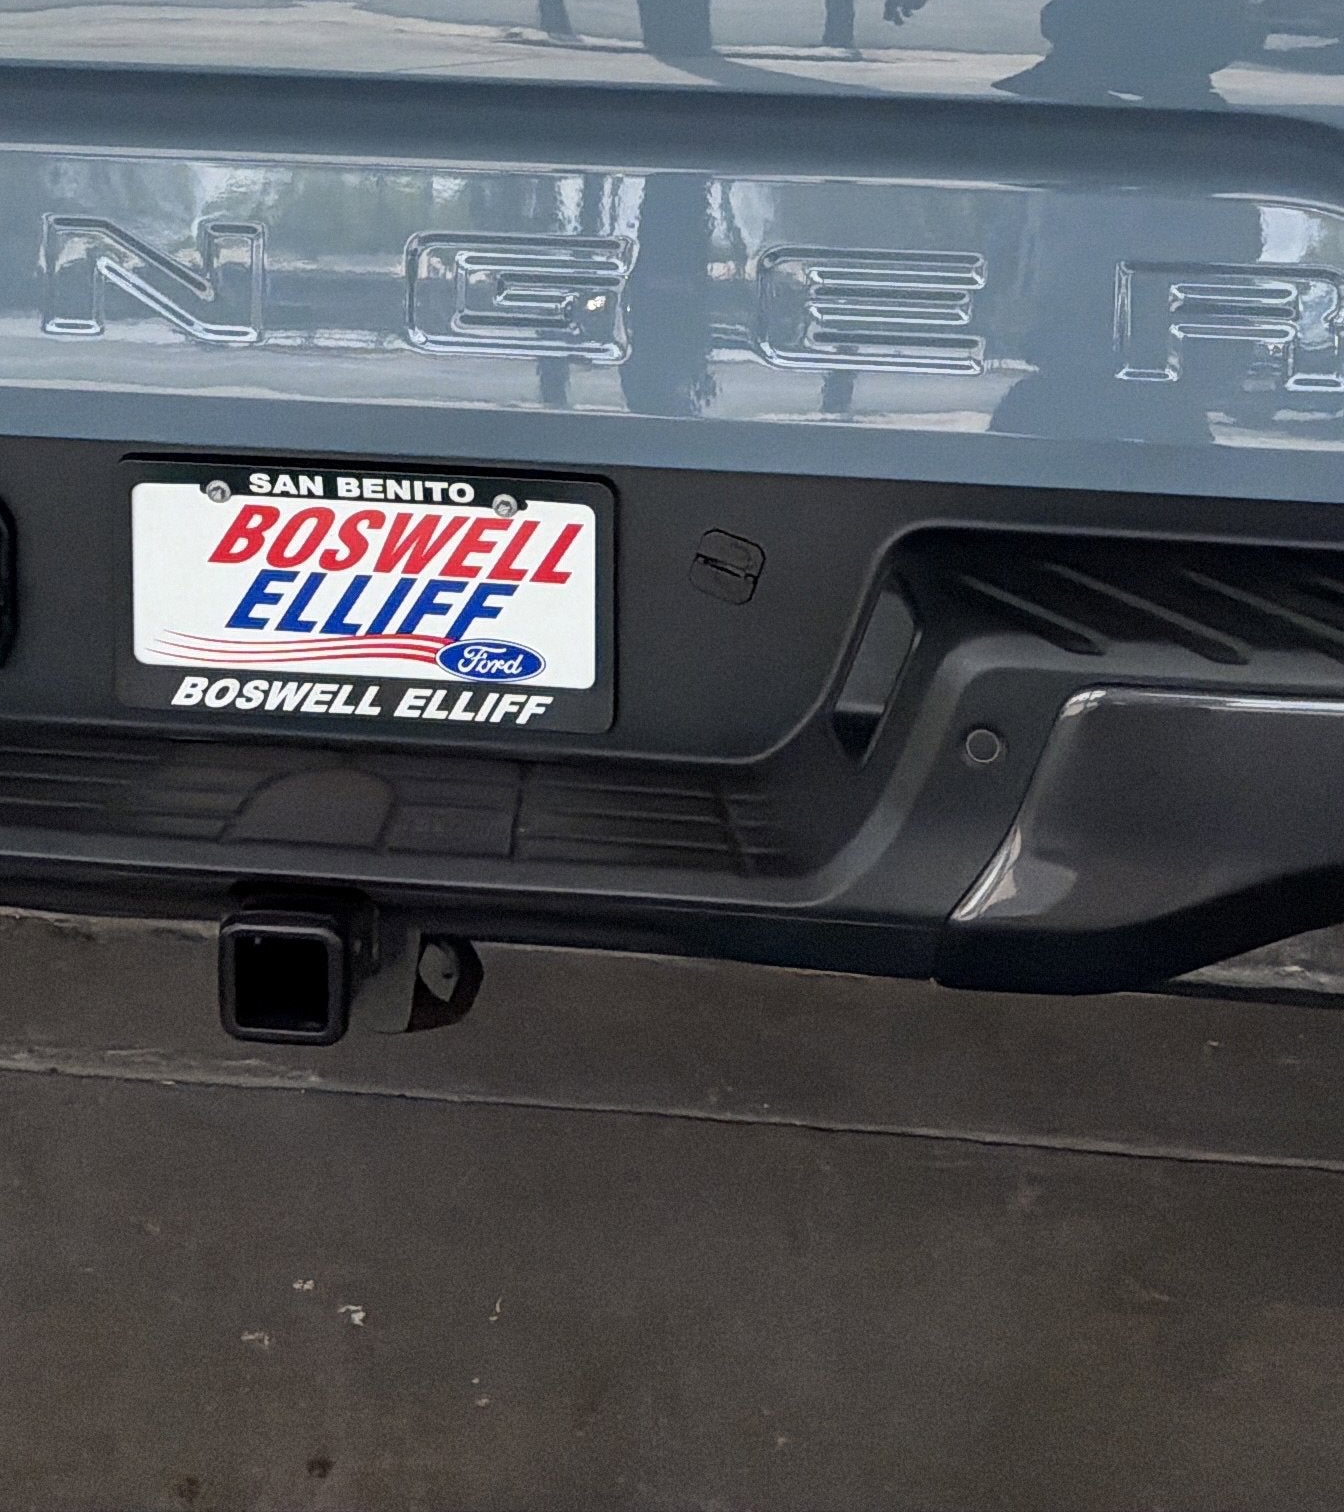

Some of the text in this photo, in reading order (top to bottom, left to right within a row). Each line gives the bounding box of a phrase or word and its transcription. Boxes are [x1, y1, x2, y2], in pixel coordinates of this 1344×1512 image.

[249, 472, 475, 503] SAN BENITO
[207, 504, 584, 585] BOSWELL
[225, 569, 519, 642] ELLIFF
[458, 644, 523, 676] Ford
[171, 676, 554, 726] BOSWELL ELLIFF
